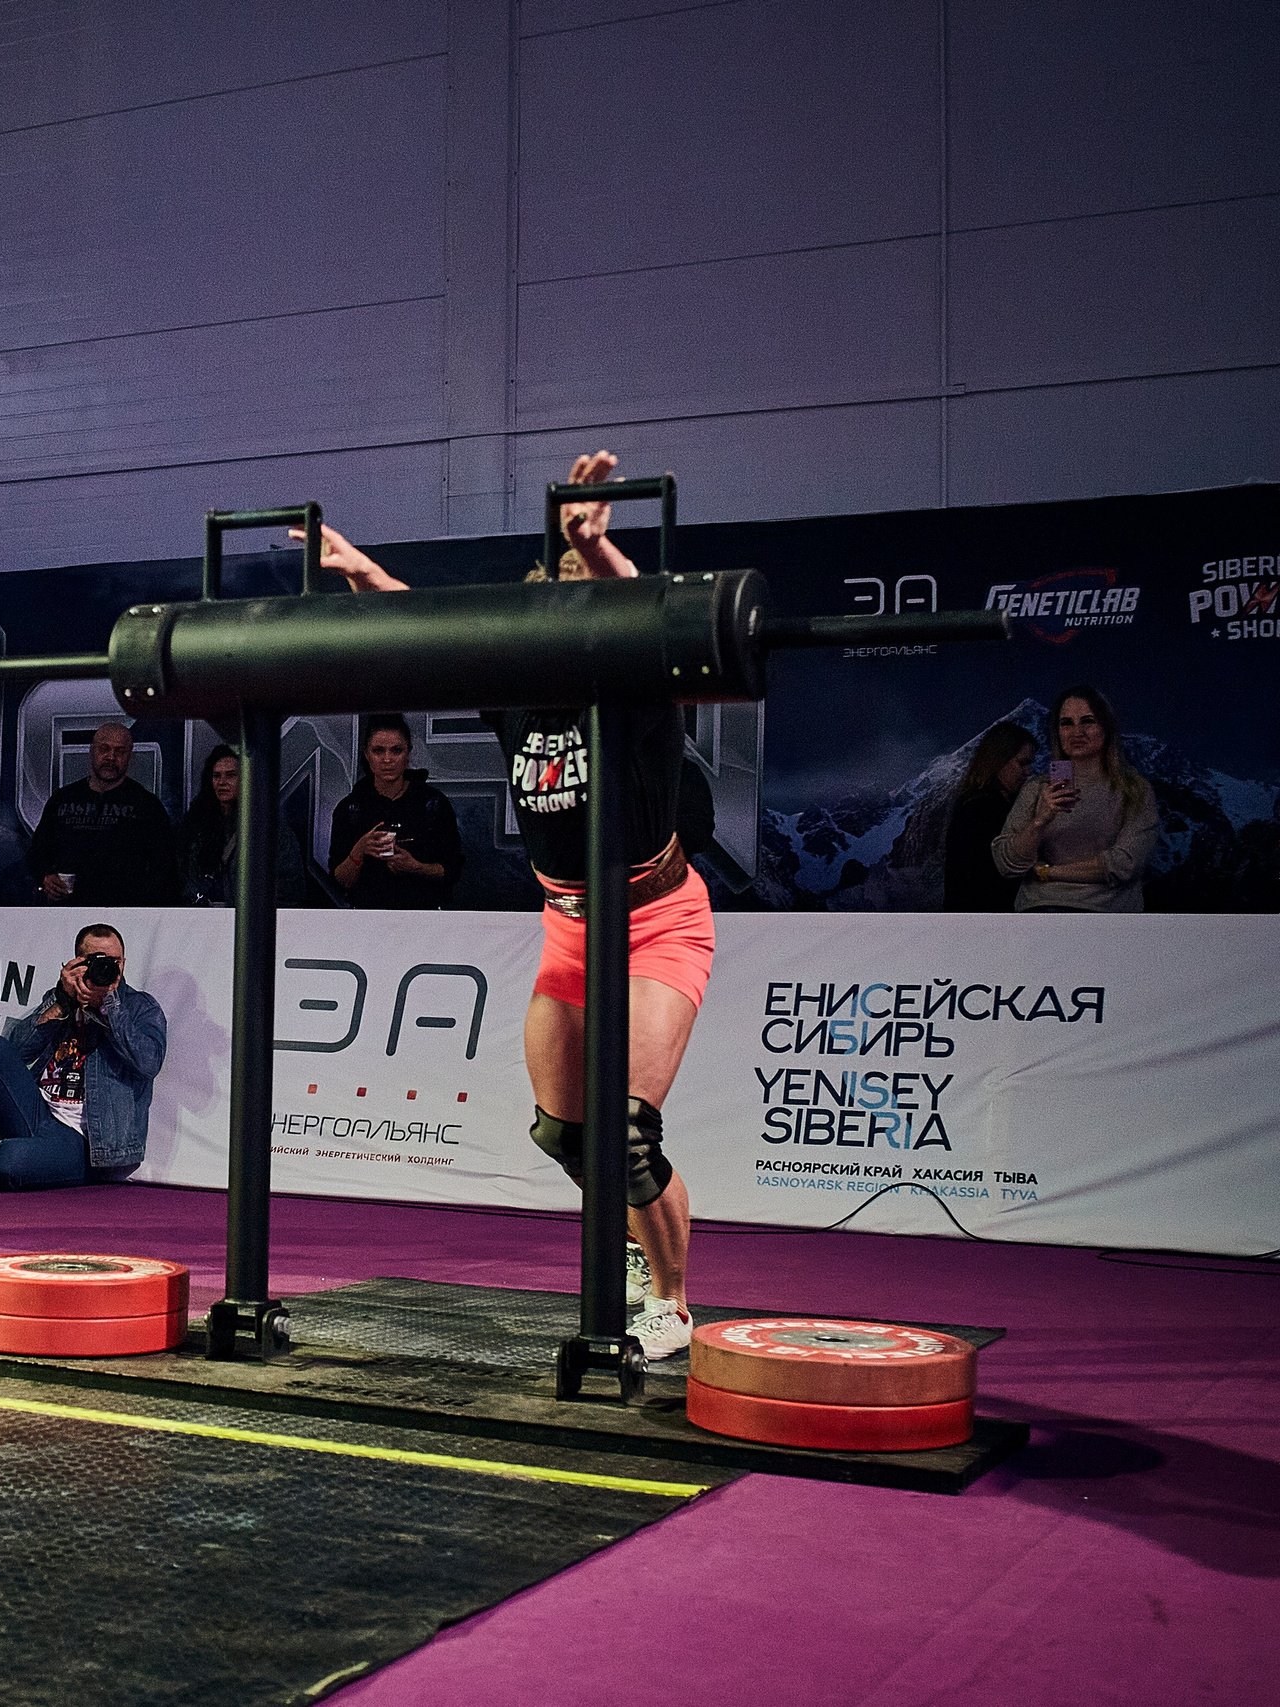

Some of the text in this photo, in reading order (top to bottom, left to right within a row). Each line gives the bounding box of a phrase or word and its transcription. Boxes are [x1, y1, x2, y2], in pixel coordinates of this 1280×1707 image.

[1202, 555, 1280, 584] SIBERI
[985, 583, 1140, 618] GENETICLAB
[1188, 580, 1280, 624] POW
[1064, 614, 1134, 627] NUTRITION
[842, 644, 938, 658] ЭНЕРГОАЛЬЯНС
[526, 790, 577, 813] SHOW
[764, 978, 1106, 1024] ЕНИСЕЙСКАЯ
[761, 1018, 955, 1058] СИБИРЬ
[753, 1067, 954, 1111] YENISEY
[271, 1113, 462, 1145] НЕРГОАЛЬЯНС
[760, 1107, 952, 1151] SIBERIA
[270, 1145, 455, 1166] ИЙСКИЙ ЭНЕРГЕТИЧЕСКИЙ ХОЛДИНГ
[863, 1164, 903, 1179] КРАЙ
[912, 1168, 983, 1182] ХАКАСИЯ
[993, 1171, 1038, 1185] ТЫВА
[846, 1181, 900, 1195] REGION
[910, 1185, 990, 1199] KHAKASSIA
[1001, 1188, 1039, 1201] TYVA
